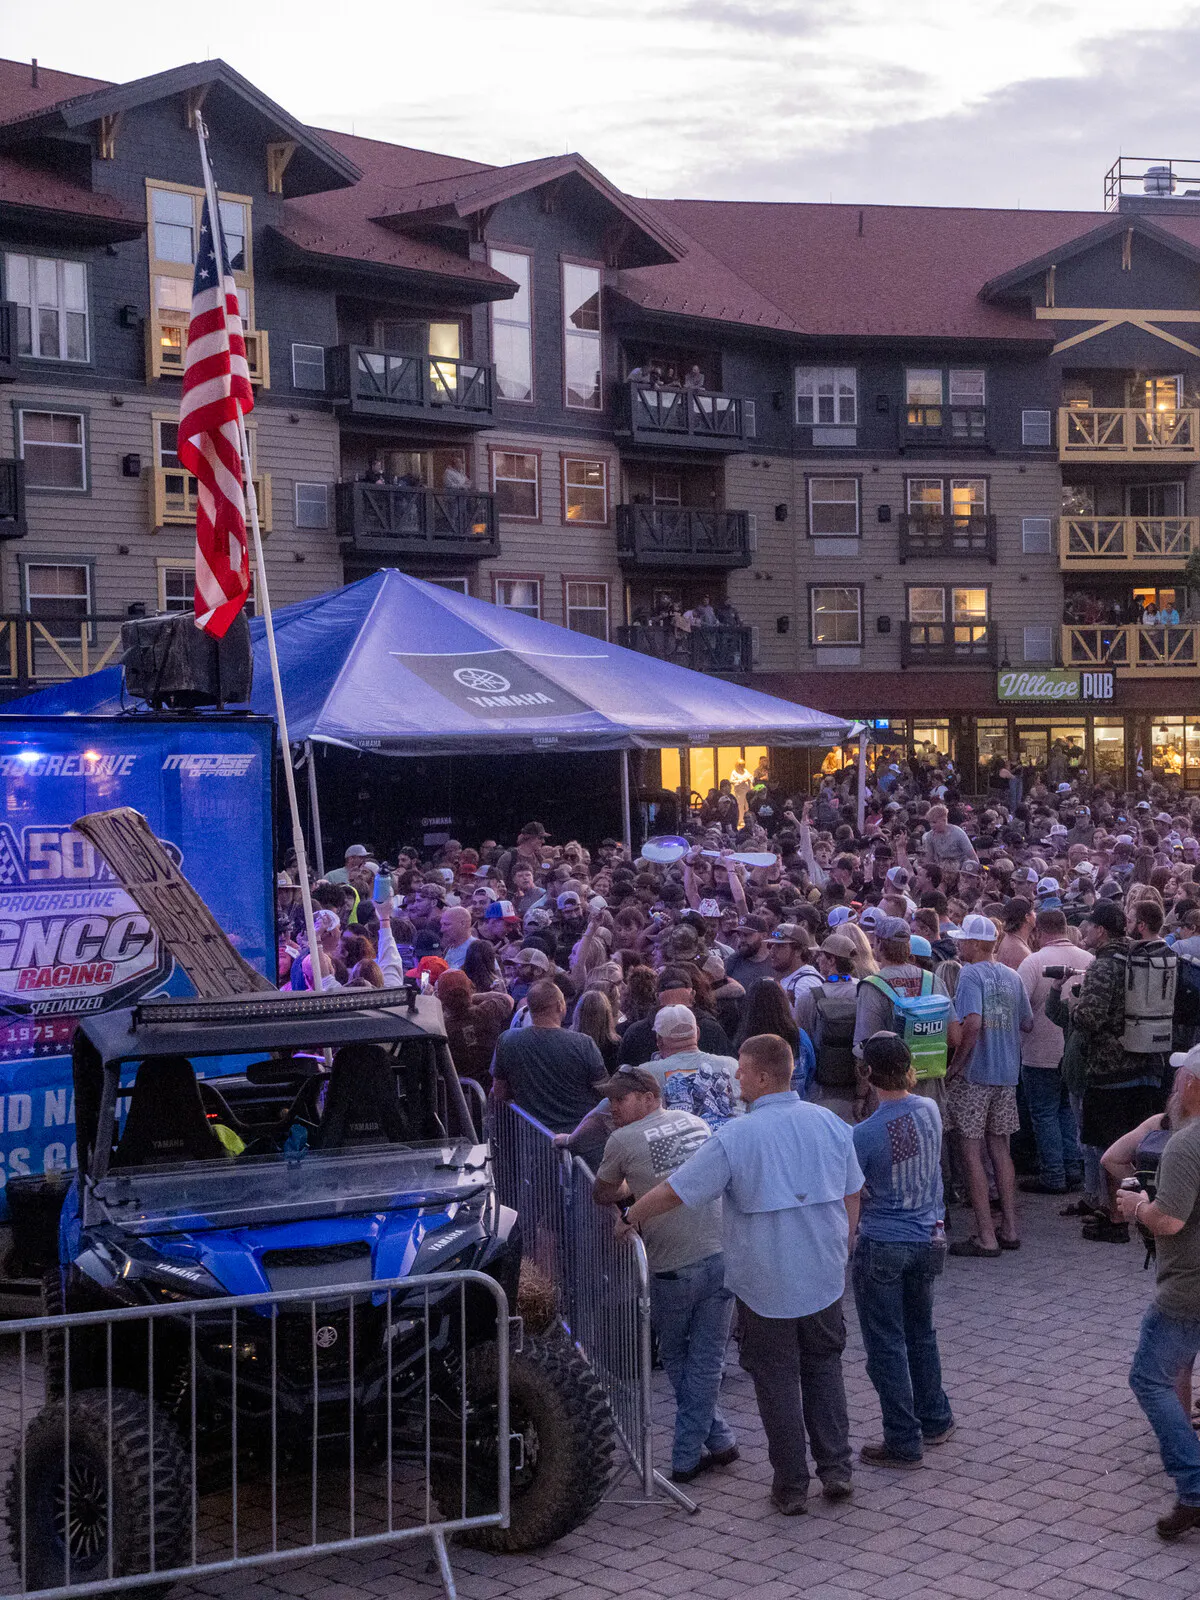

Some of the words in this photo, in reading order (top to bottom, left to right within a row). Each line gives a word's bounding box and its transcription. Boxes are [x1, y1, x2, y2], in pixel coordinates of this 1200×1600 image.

[1000, 673, 1079, 699] Village
[1083, 673, 1114, 699] PUB
[467, 691, 555, 708] YAMAHA
[358, 740, 381, 748] YAMAHA
[161, 754, 256, 770] MOOSE
[188, 769, 247, 777] OFFROAD
[28, 832, 95, 880] 50
[0, 889, 116, 912] PROGRESSIVE
[16, 962, 115, 992] RACING
[29, 997, 104, 1015] SPECIALIZED
[7, 1025, 54, 1043] 1975
[428, 1229, 466, 1251] YAMAHA
[155, 1263, 201, 1281] YAMAHA
